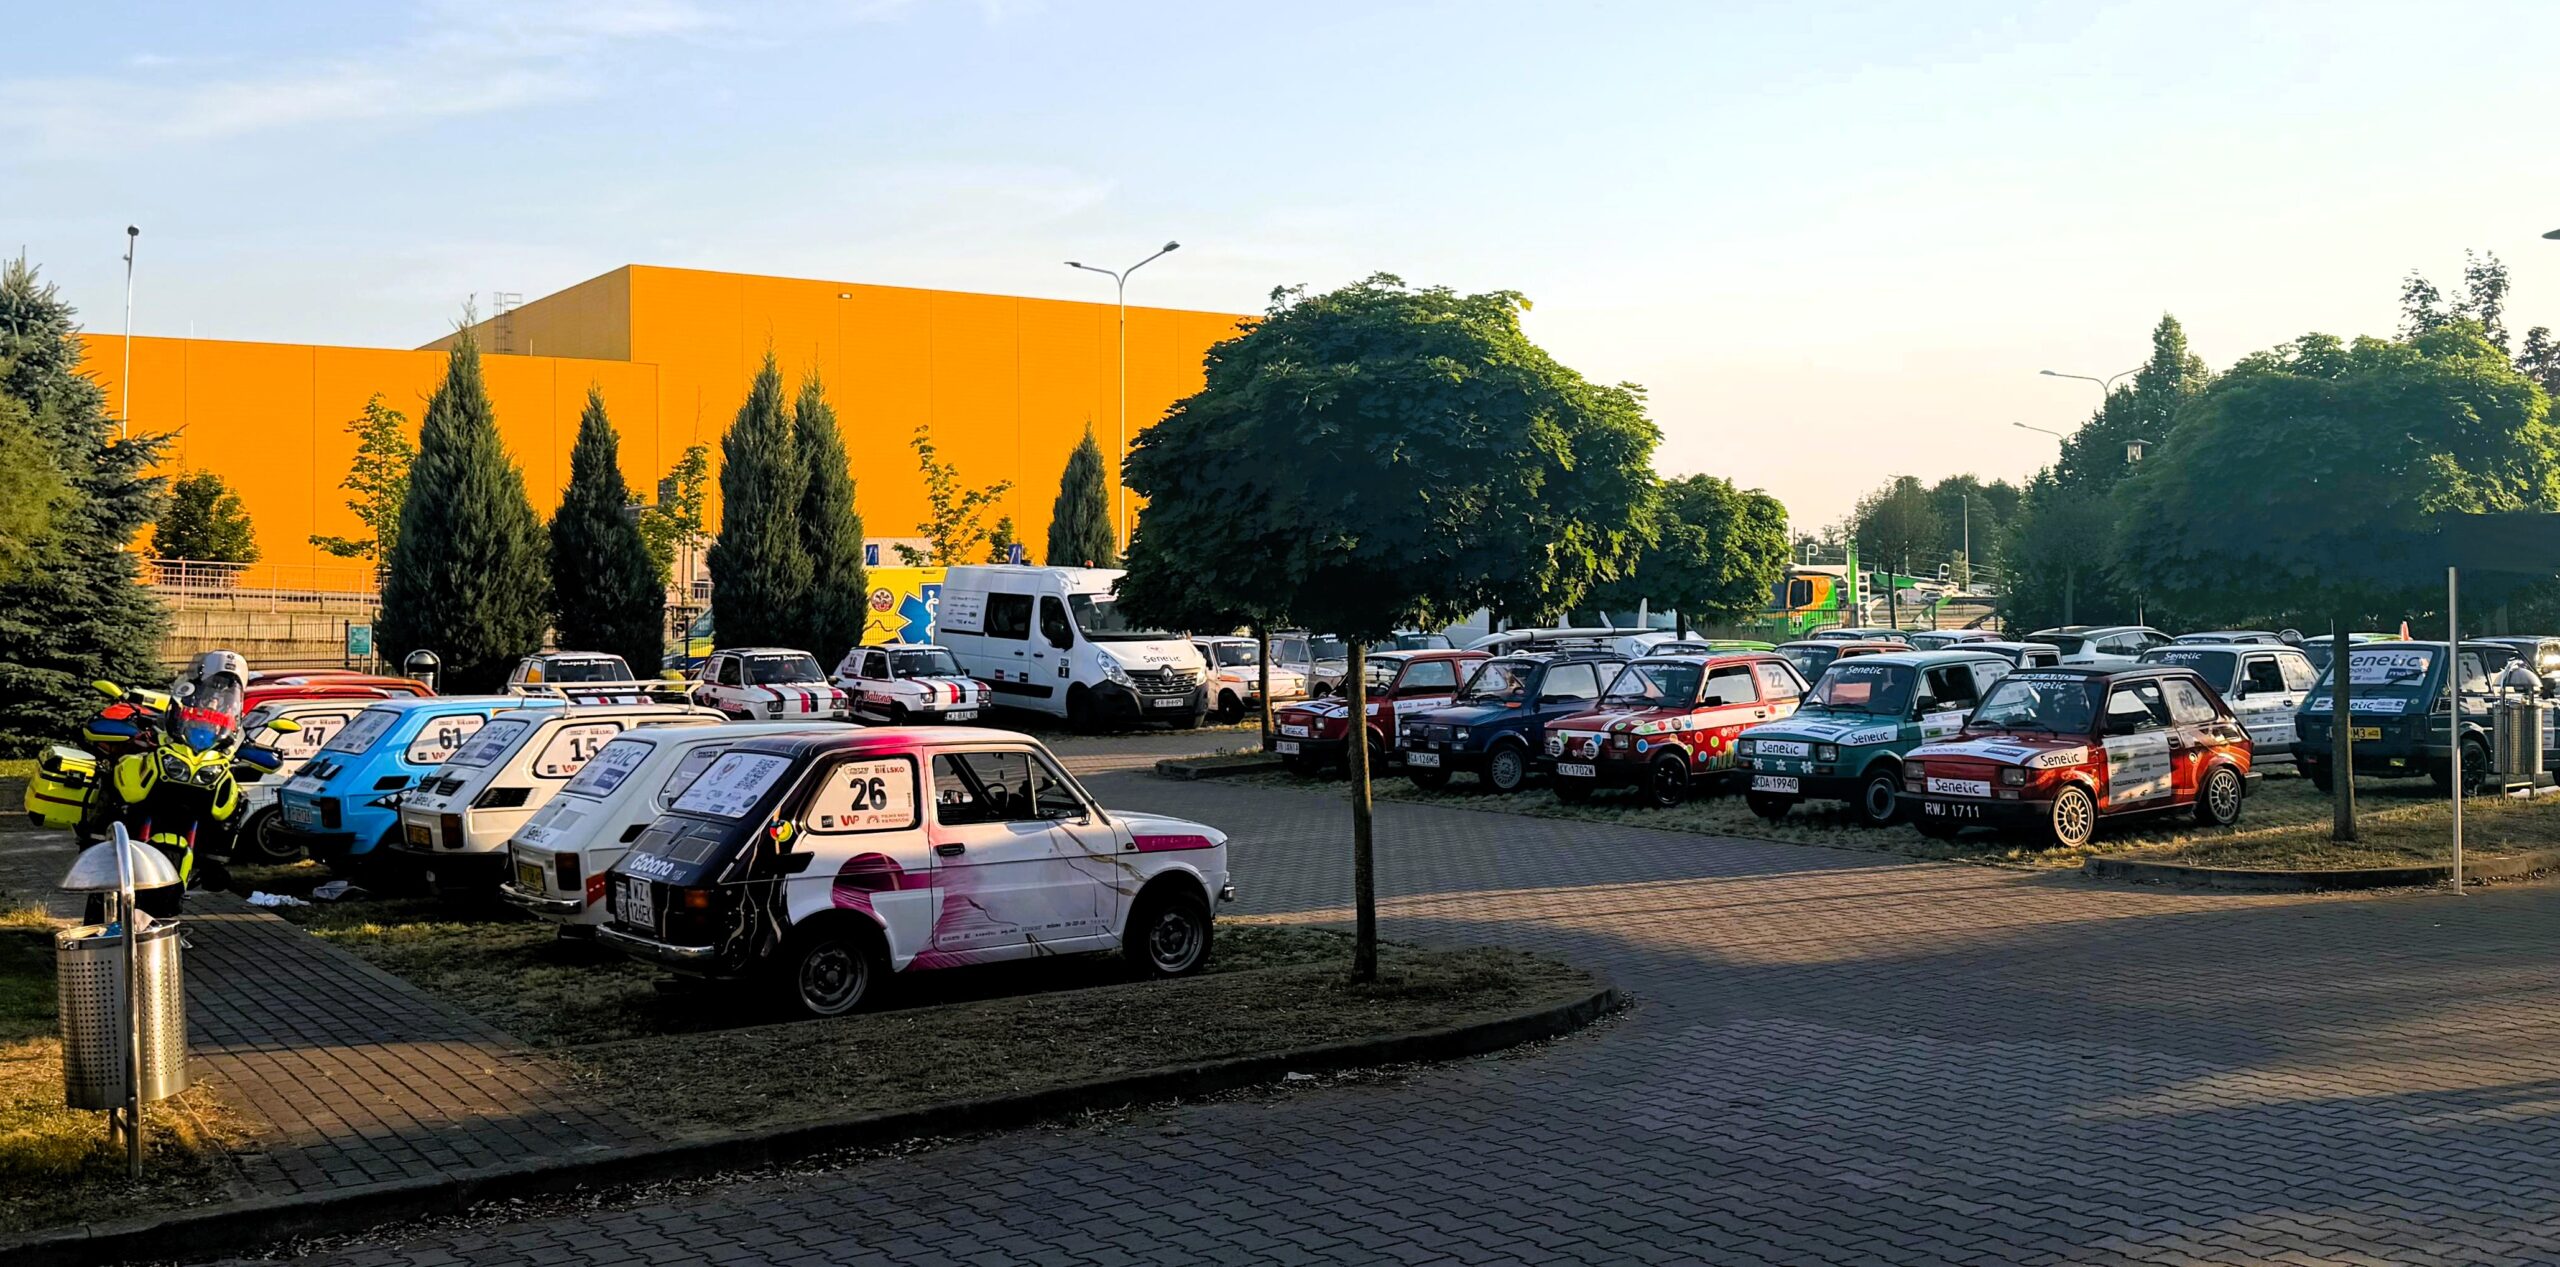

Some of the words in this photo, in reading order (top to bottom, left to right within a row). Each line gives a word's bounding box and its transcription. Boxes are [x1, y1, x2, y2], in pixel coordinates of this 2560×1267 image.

[1143, 654, 1182, 663] Senetic
[2165, 652, 2202, 660] Senetic
[2349, 654, 2420, 667] enetic
[1846, 665, 1883, 675] Senetic
[1768, 671, 1785, 689] 22
[302, 726, 327, 747] 47
[438, 727, 463, 750] 61
[1851, 732, 1889, 745] Senetic
[570, 738, 598, 762] 15
[1762, 742, 1800, 755] Senetic
[2041, 753, 2080, 767] Senetic
[1756, 776, 1770, 788] KDA
[1772, 778, 1797, 790] 19940
[1936, 779, 1980, 794] Senetic
[849, 776, 887, 811] 26
[1925, 802, 1946, 816] RWJ
[1952, 805, 1980, 818] 1711
[841, 815, 860, 827] WP
[632, 880, 646, 899] WZ
[630, 903, 654, 925] 126EK
